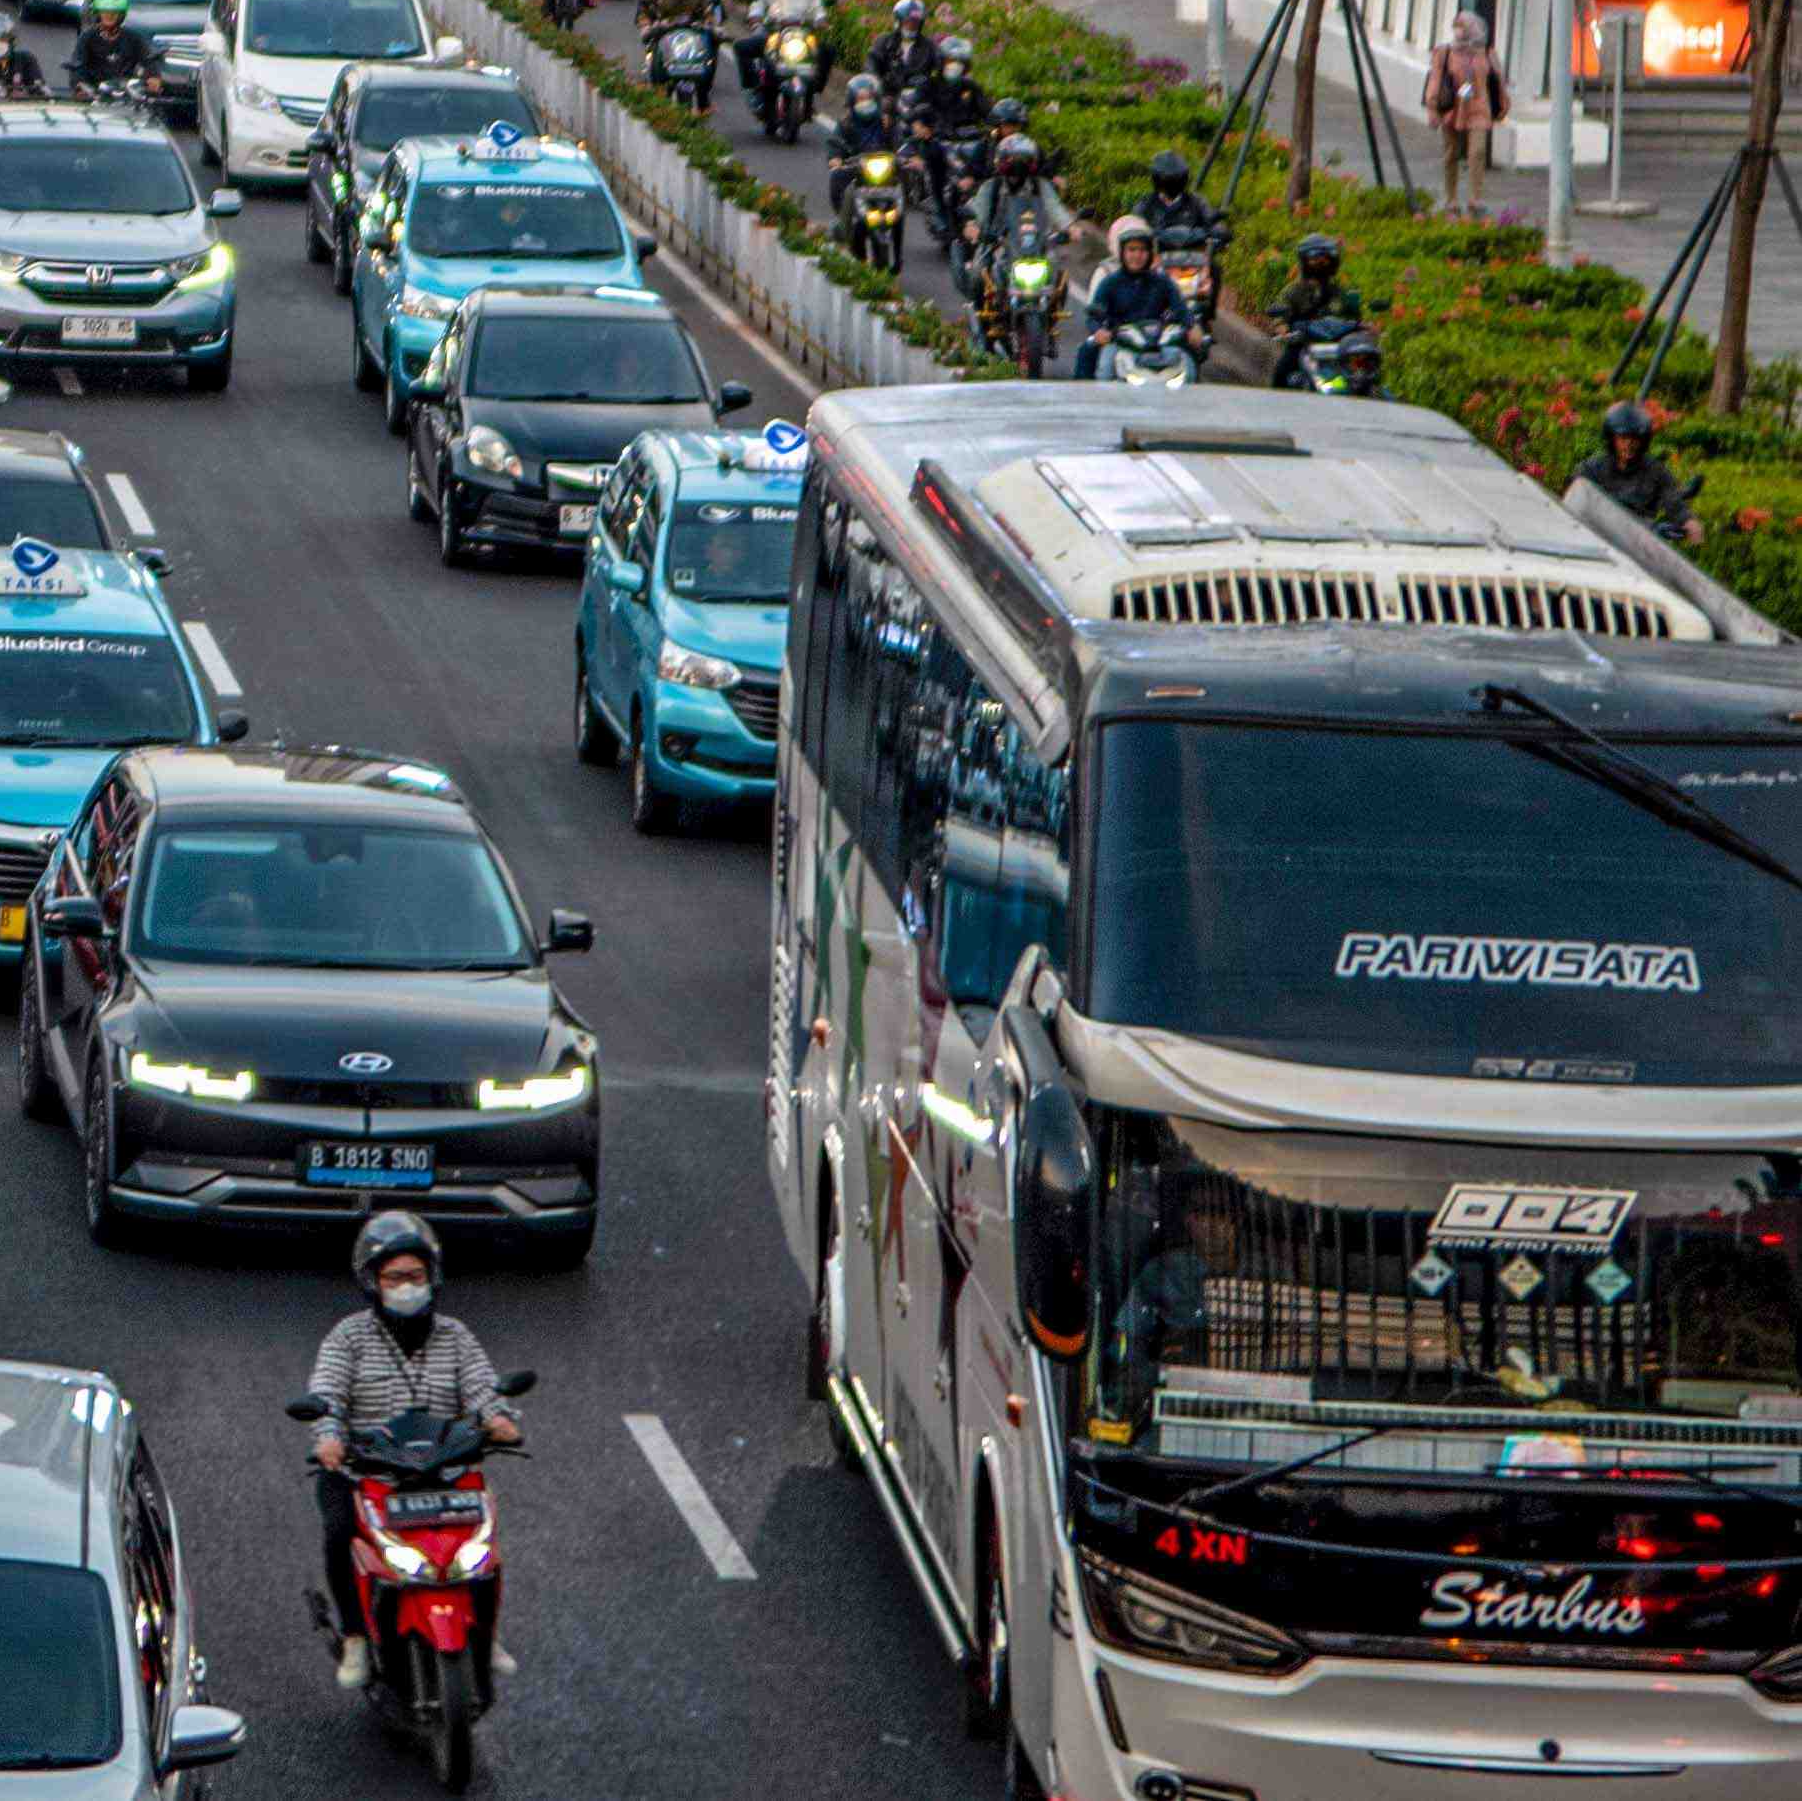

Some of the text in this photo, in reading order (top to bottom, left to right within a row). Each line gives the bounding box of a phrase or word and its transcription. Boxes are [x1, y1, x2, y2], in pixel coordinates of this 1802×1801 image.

[474, 184, 542, 197] Bluebird
[3, 577, 63, 592] TAKSI
[87, 640, 147, 658] Group
[1335, 932, 1701, 991] PARIWISATA
[311, 1148, 323, 1167] B
[334, 1148, 381, 1168] 1812
[1439, 1190, 1619, 1234] 004
[1155, 1527, 1247, 1565] 4 XN
[1419, 1570, 1646, 1635] Starbus
